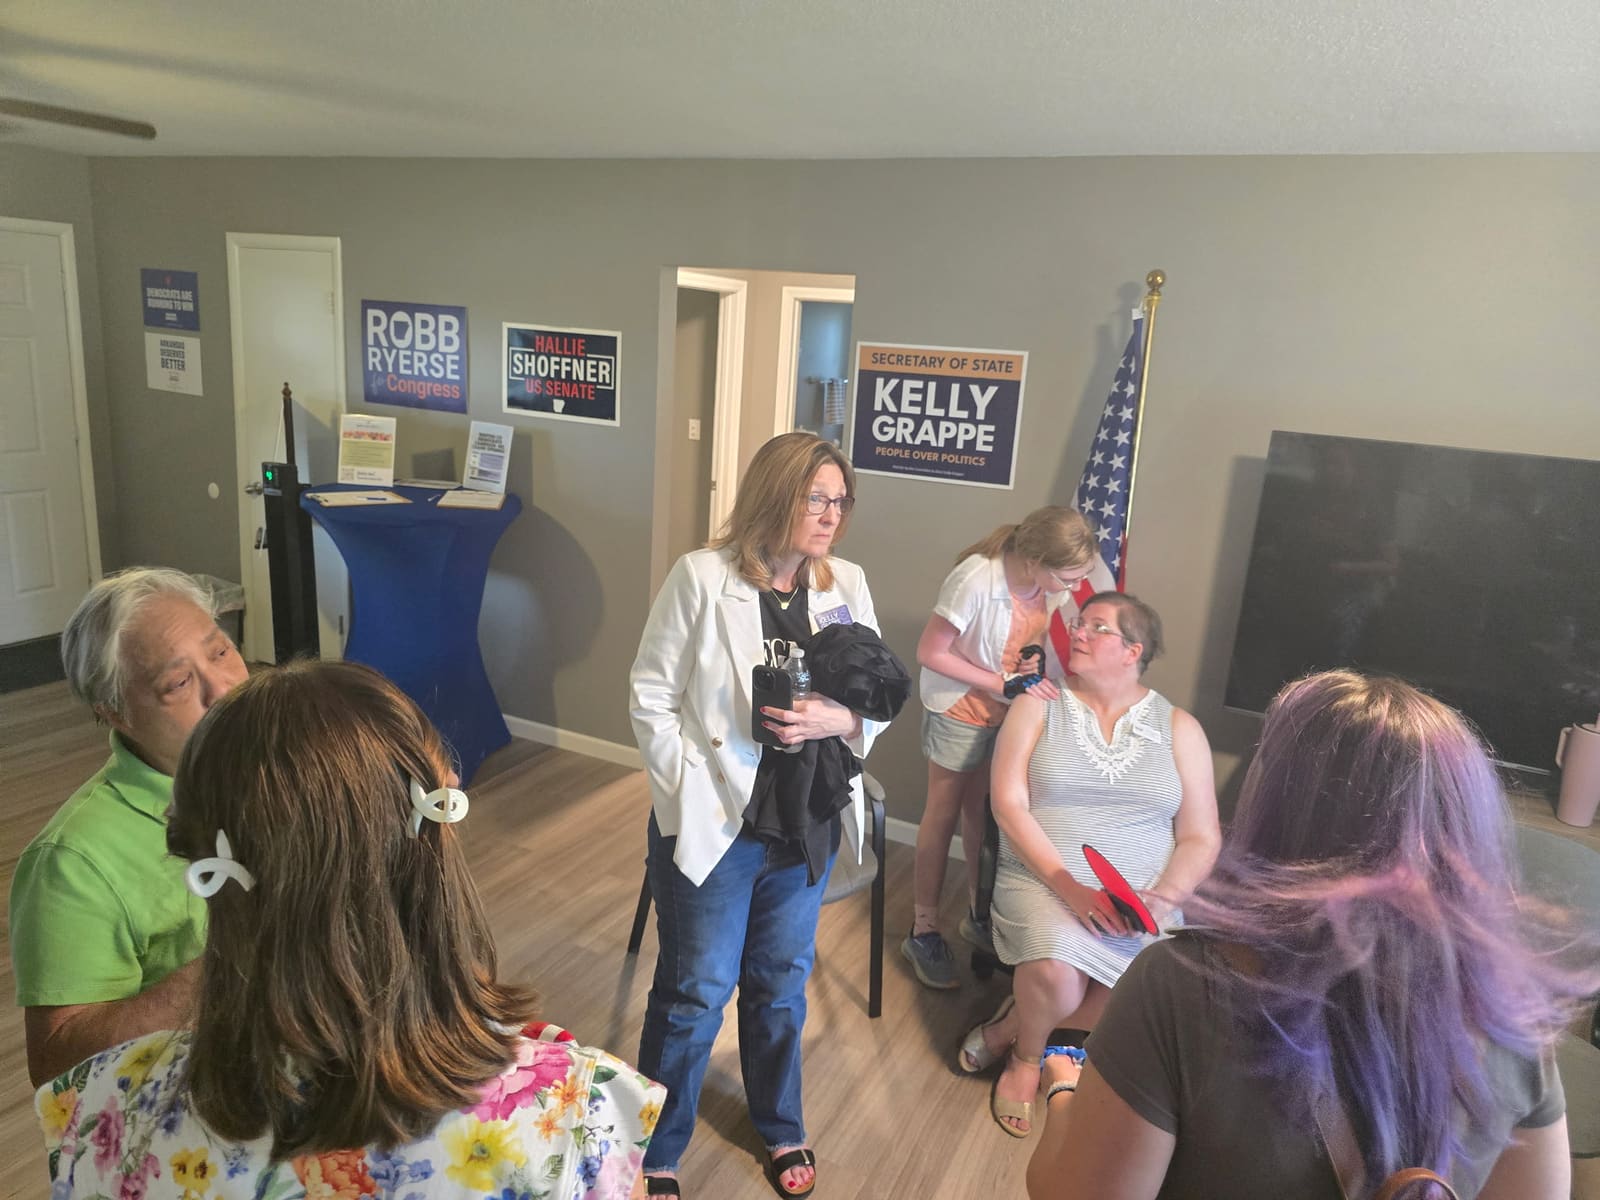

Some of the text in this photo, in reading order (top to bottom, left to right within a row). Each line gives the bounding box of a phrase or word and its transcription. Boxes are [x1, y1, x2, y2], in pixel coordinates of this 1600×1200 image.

[367, 308, 460, 353] ROBB
[535, 335, 586, 357] HALLIE
[161, 358, 185, 370] BETTER
[367, 346, 460, 380] RYERSE
[512, 352, 611, 384] SHOFFNER
[871, 352, 1014, 374] SECRETARY OF STATE
[386, 373, 460, 400] Congress
[525, 378, 596, 401] US SENATE
[873, 377, 999, 421] KELLY
[872, 415, 996, 453] GRAPPE
[875, 446, 986, 467] PEOPLE OVER POLITICS
